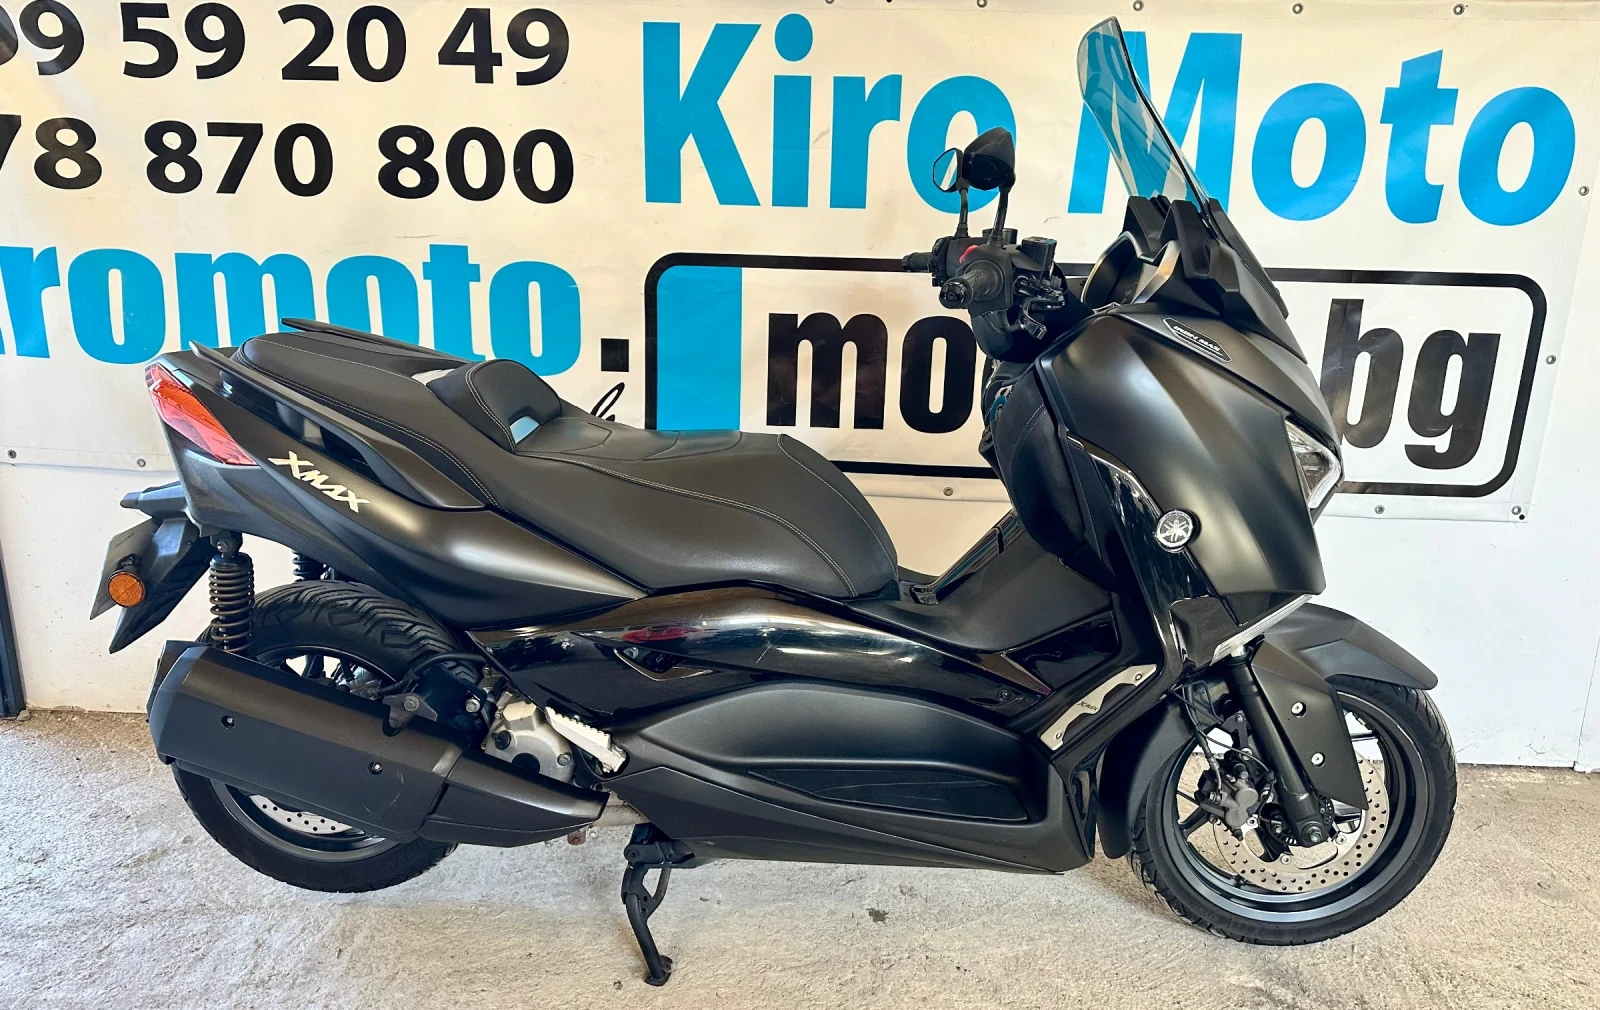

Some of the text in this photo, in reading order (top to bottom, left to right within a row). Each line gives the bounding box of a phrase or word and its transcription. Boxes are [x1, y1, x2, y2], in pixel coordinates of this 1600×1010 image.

[120, 2, 245, 80] 59
[277, 4, 406, 82] 20
[438, 7, 570, 86] 49
[642, 13, 1577, 227] Kiro Moto
[144, 120, 334, 197] 870
[377, 124, 574, 205] 800
[267, 450, 371, 509] XMAX
